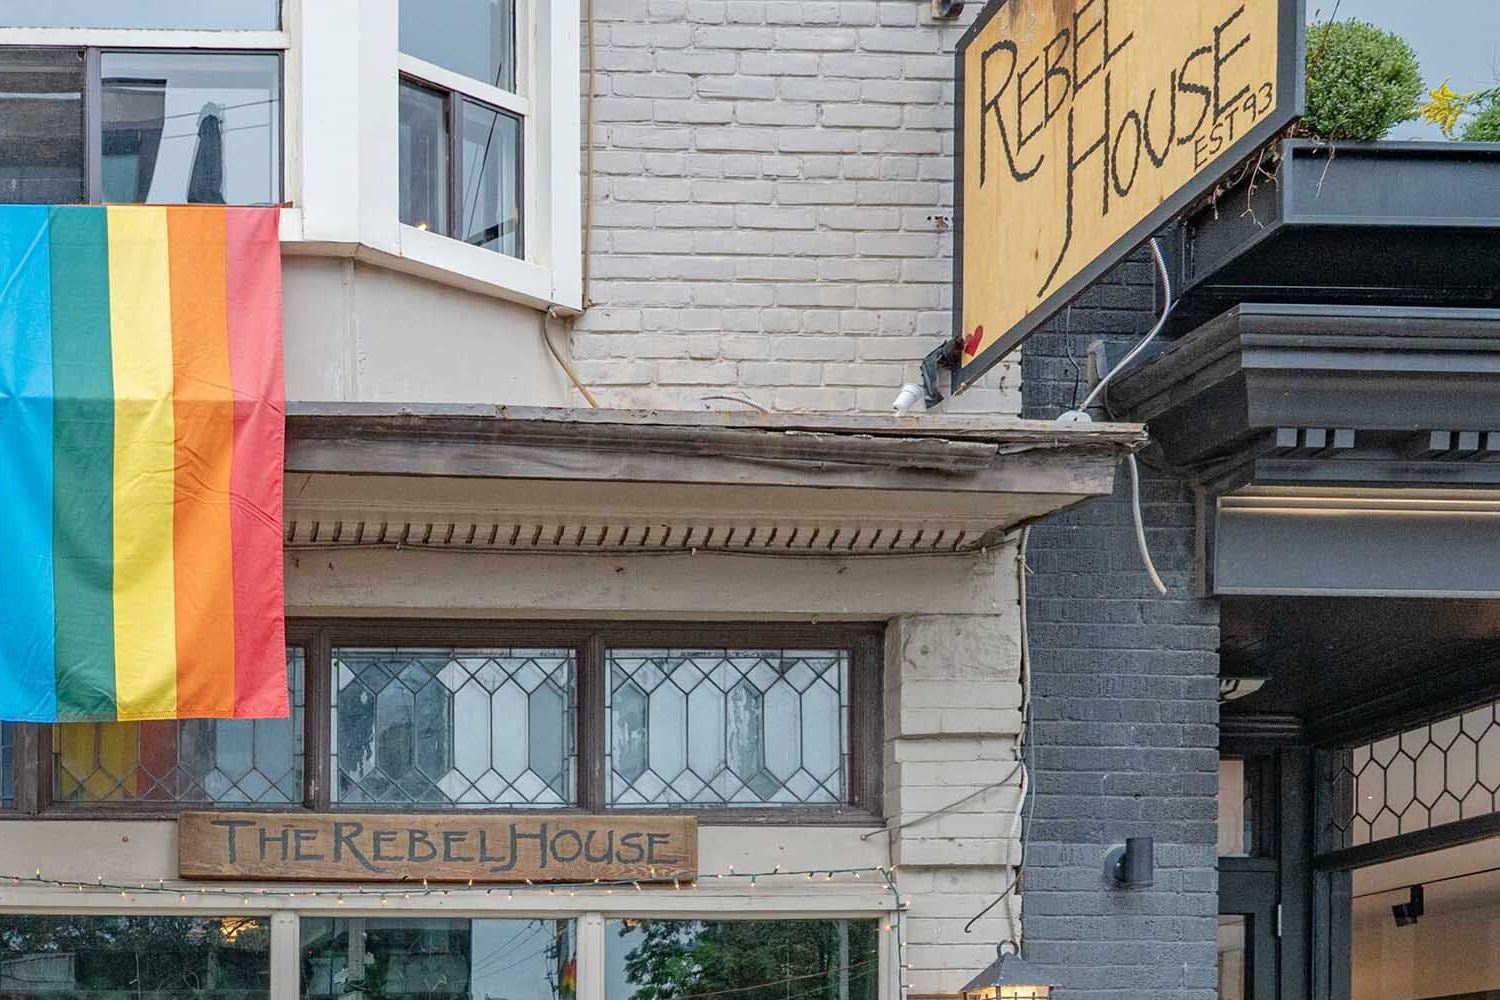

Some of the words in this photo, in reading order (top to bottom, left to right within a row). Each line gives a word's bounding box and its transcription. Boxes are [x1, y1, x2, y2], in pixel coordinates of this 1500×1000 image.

[980, 0, 1134, 189] REBEL
[1037, 4, 1251, 297] HOUSE
[1194, 106, 1239, 172] EST
[1242, 82, 1273, 123] 93
